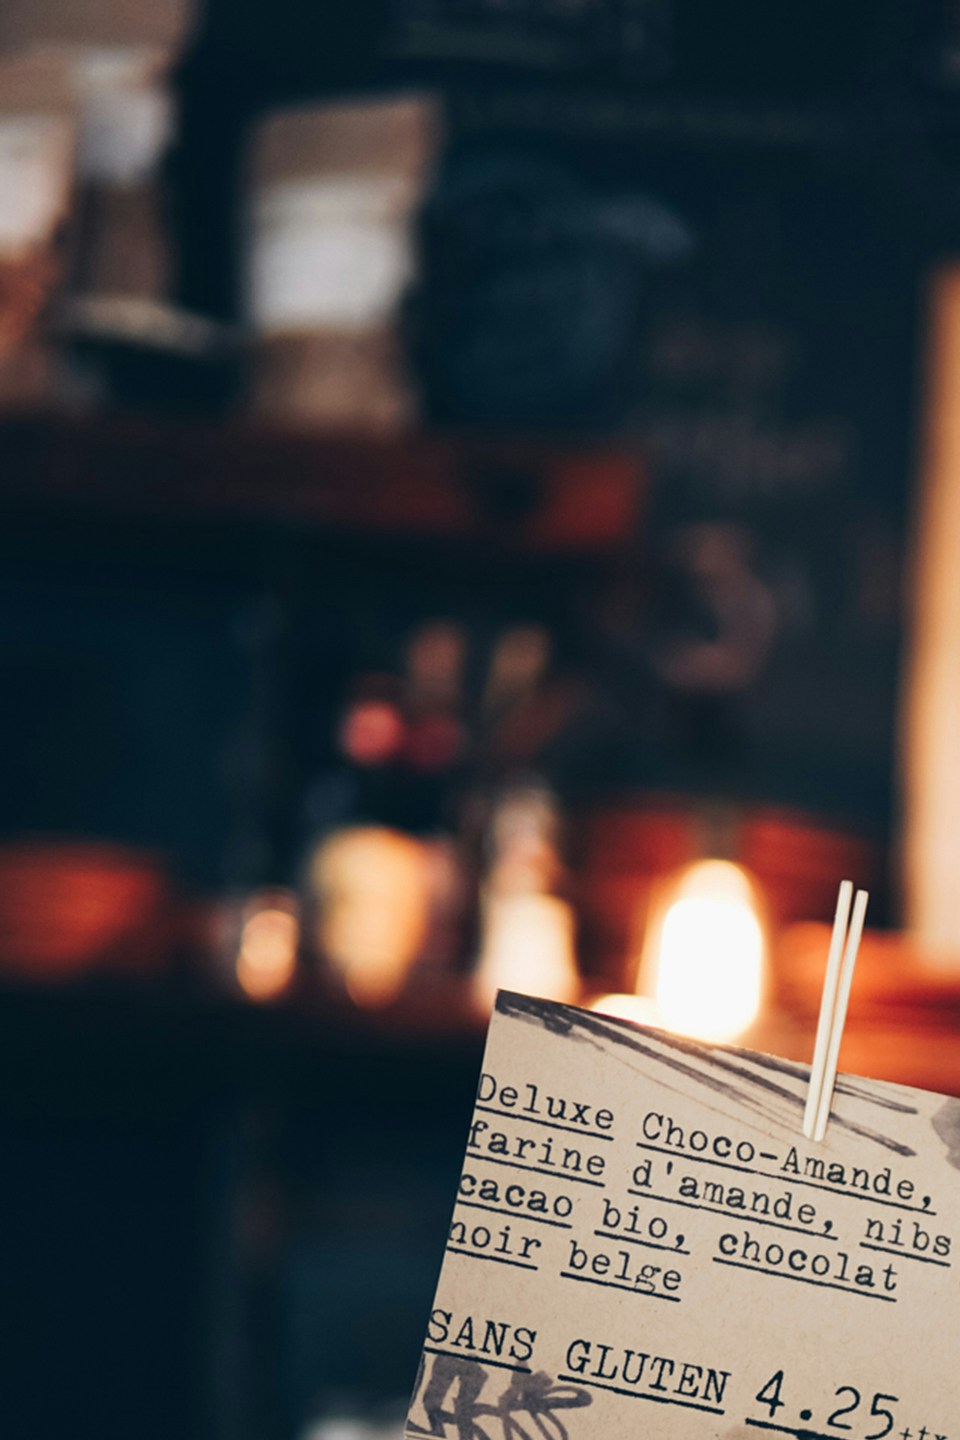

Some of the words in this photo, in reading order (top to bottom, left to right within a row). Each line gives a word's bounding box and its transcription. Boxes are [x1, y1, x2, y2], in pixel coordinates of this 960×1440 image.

[466, 1119, 606, 1178] farine
[632, 1159, 834, 1225] d'amande,
[864, 1217, 952, 1256] nibs
[475, 1072, 615, 1134] Deluxe
[640, 1111, 933, 1210] Choco-Amande,
[447, 1219, 541, 1260] noir
[568, 1239, 682, 1293] belge
[456, 1172, 573, 1219] cacao
[601, 1197, 686, 1249] bio,
[716, 1231, 899, 1292] chocolat
[426, 1308, 538, 1362] SANS
[564, 1338, 732, 1404] GLUTEN
